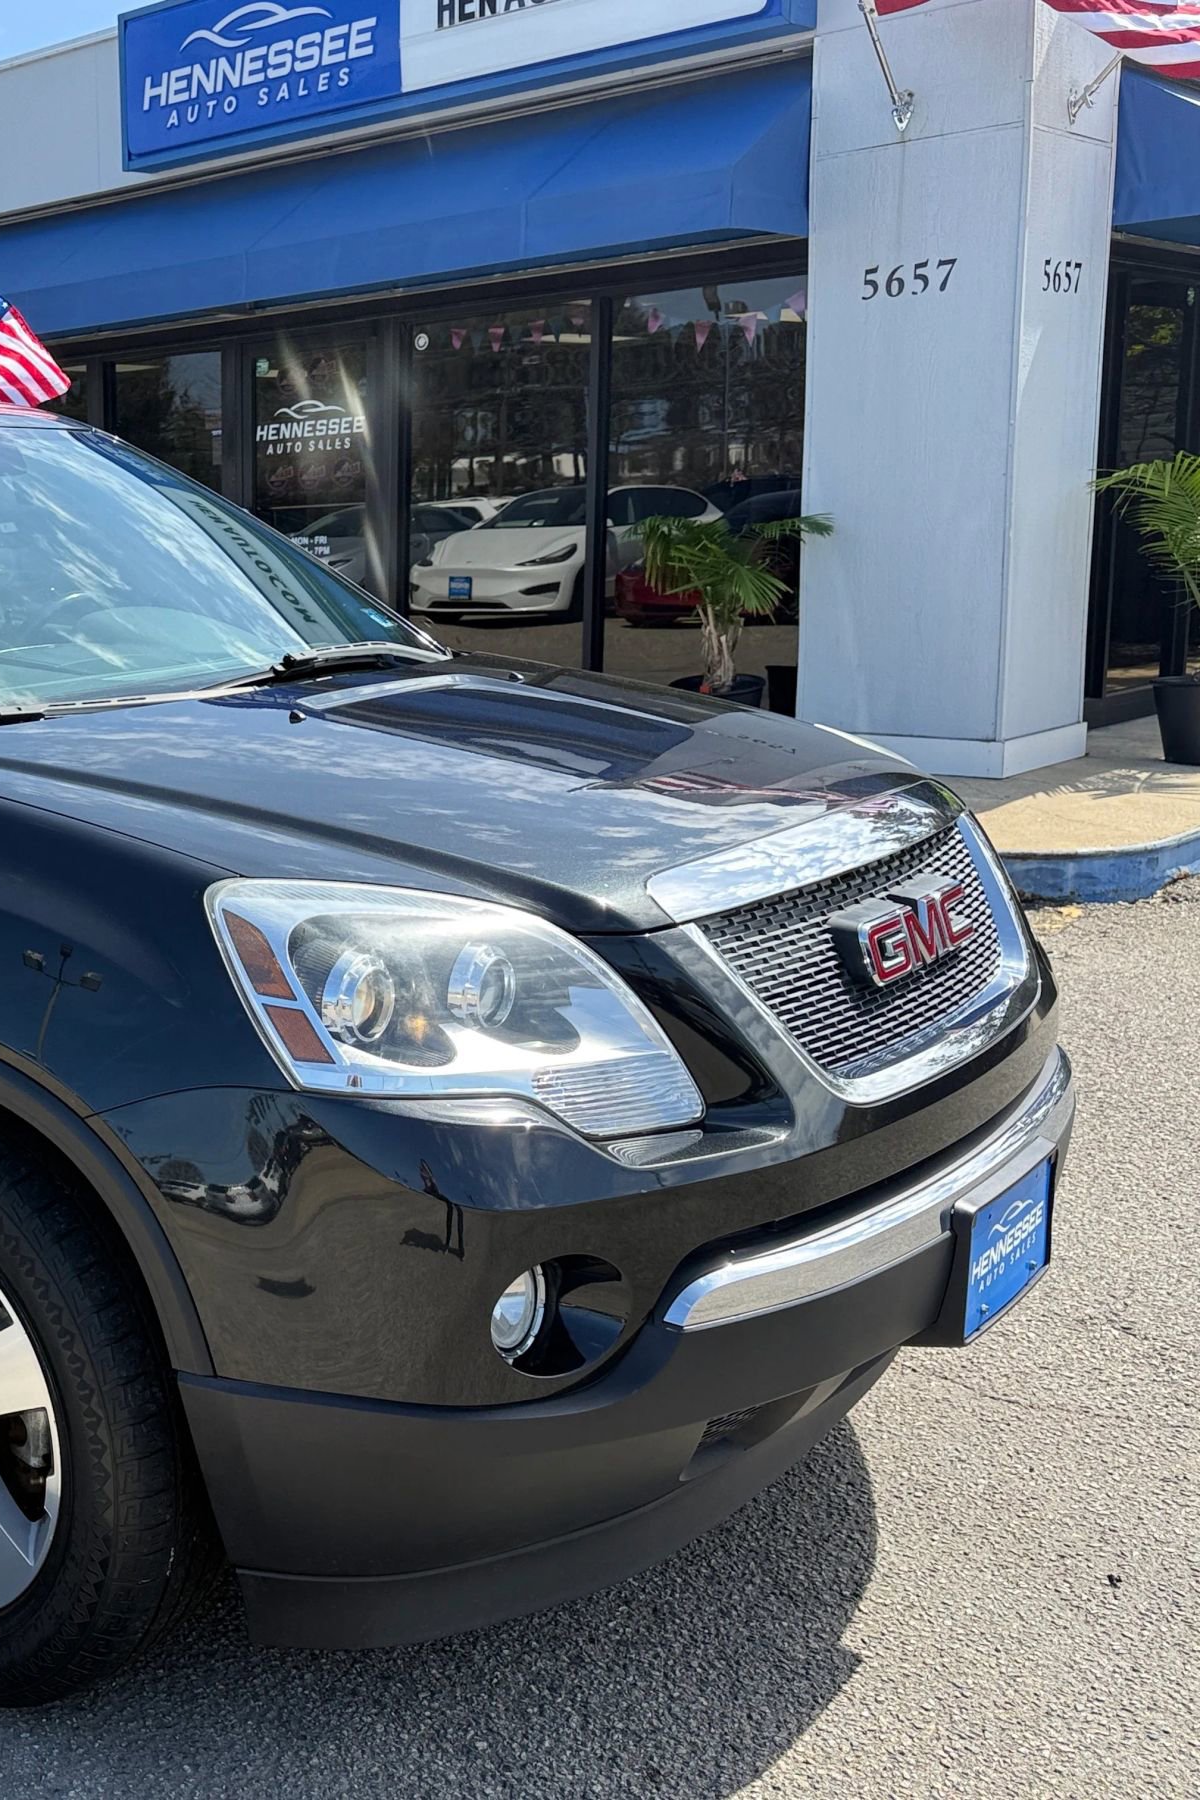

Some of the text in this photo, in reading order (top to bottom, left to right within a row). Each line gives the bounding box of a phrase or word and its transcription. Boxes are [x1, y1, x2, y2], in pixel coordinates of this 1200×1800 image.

[143, 16, 377, 111] HENNESSEE
[166, 67, 350, 128] AUTO SALES
[861, 258, 957, 300] 5657
[1042, 257, 1082, 294] 5657
[256, 416, 365, 441] HENNESSEE
[266, 437, 351, 455] AUTO SALES
[314, 535, 327, 544] FRI
[860, 883, 976, 987] GMC
[971, 1200, 1044, 1285] HENNESSEE
[978, 1231, 1037, 1293] AUTO SALES
